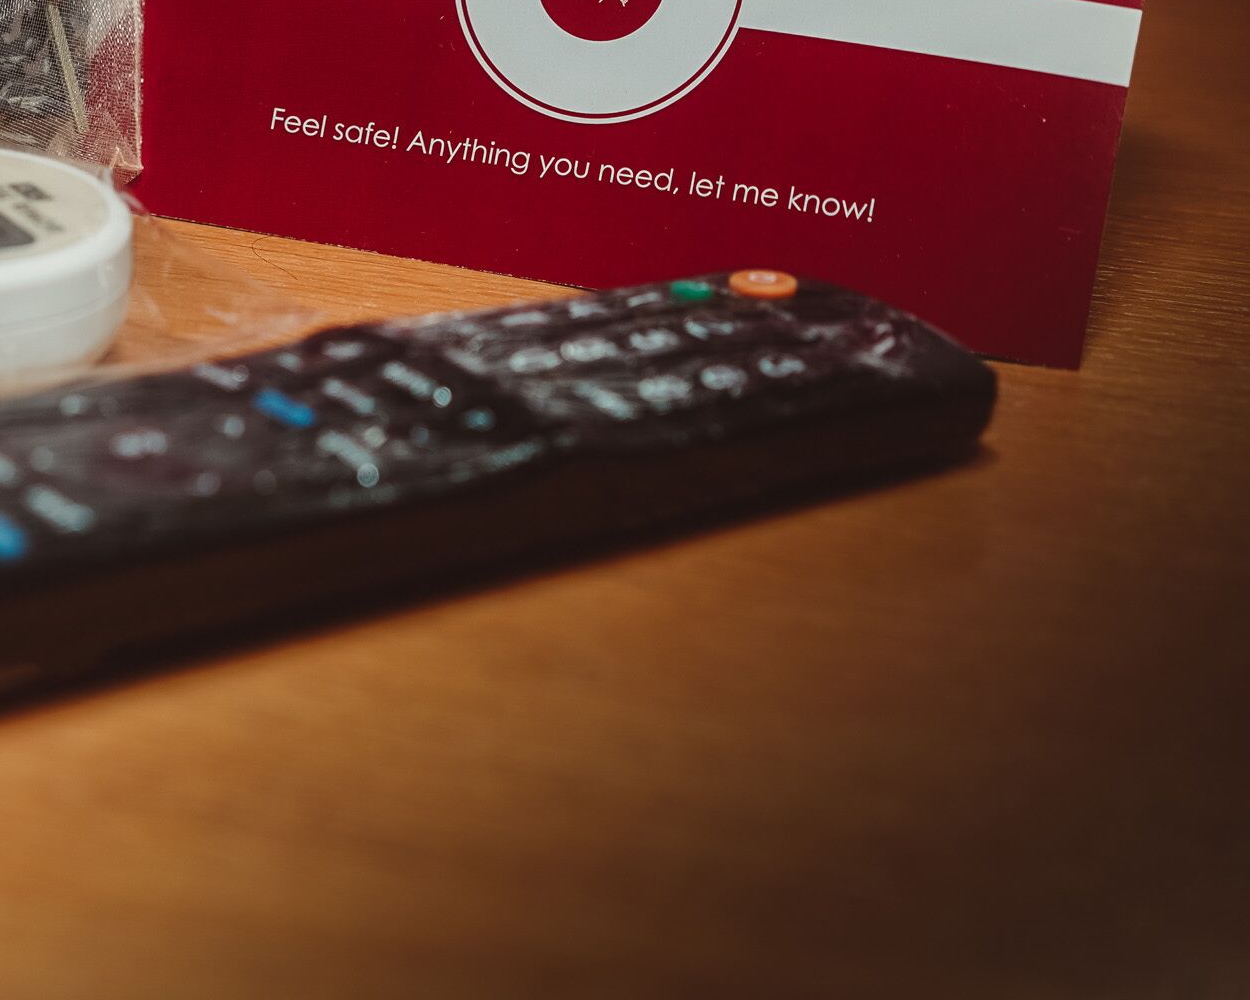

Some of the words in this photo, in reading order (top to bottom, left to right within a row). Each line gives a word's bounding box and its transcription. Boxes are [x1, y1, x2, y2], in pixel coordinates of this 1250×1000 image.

[270, 107, 327, 138] Feel
[332, 121, 400, 150] safe!
[406, 130, 531, 175] Anything
[539, 154, 591, 179] you
[598, 164, 679, 195] need,
[689, 171, 726, 199] let
[732, 183, 779, 207] me
[787, 185, 876, 223] know!
